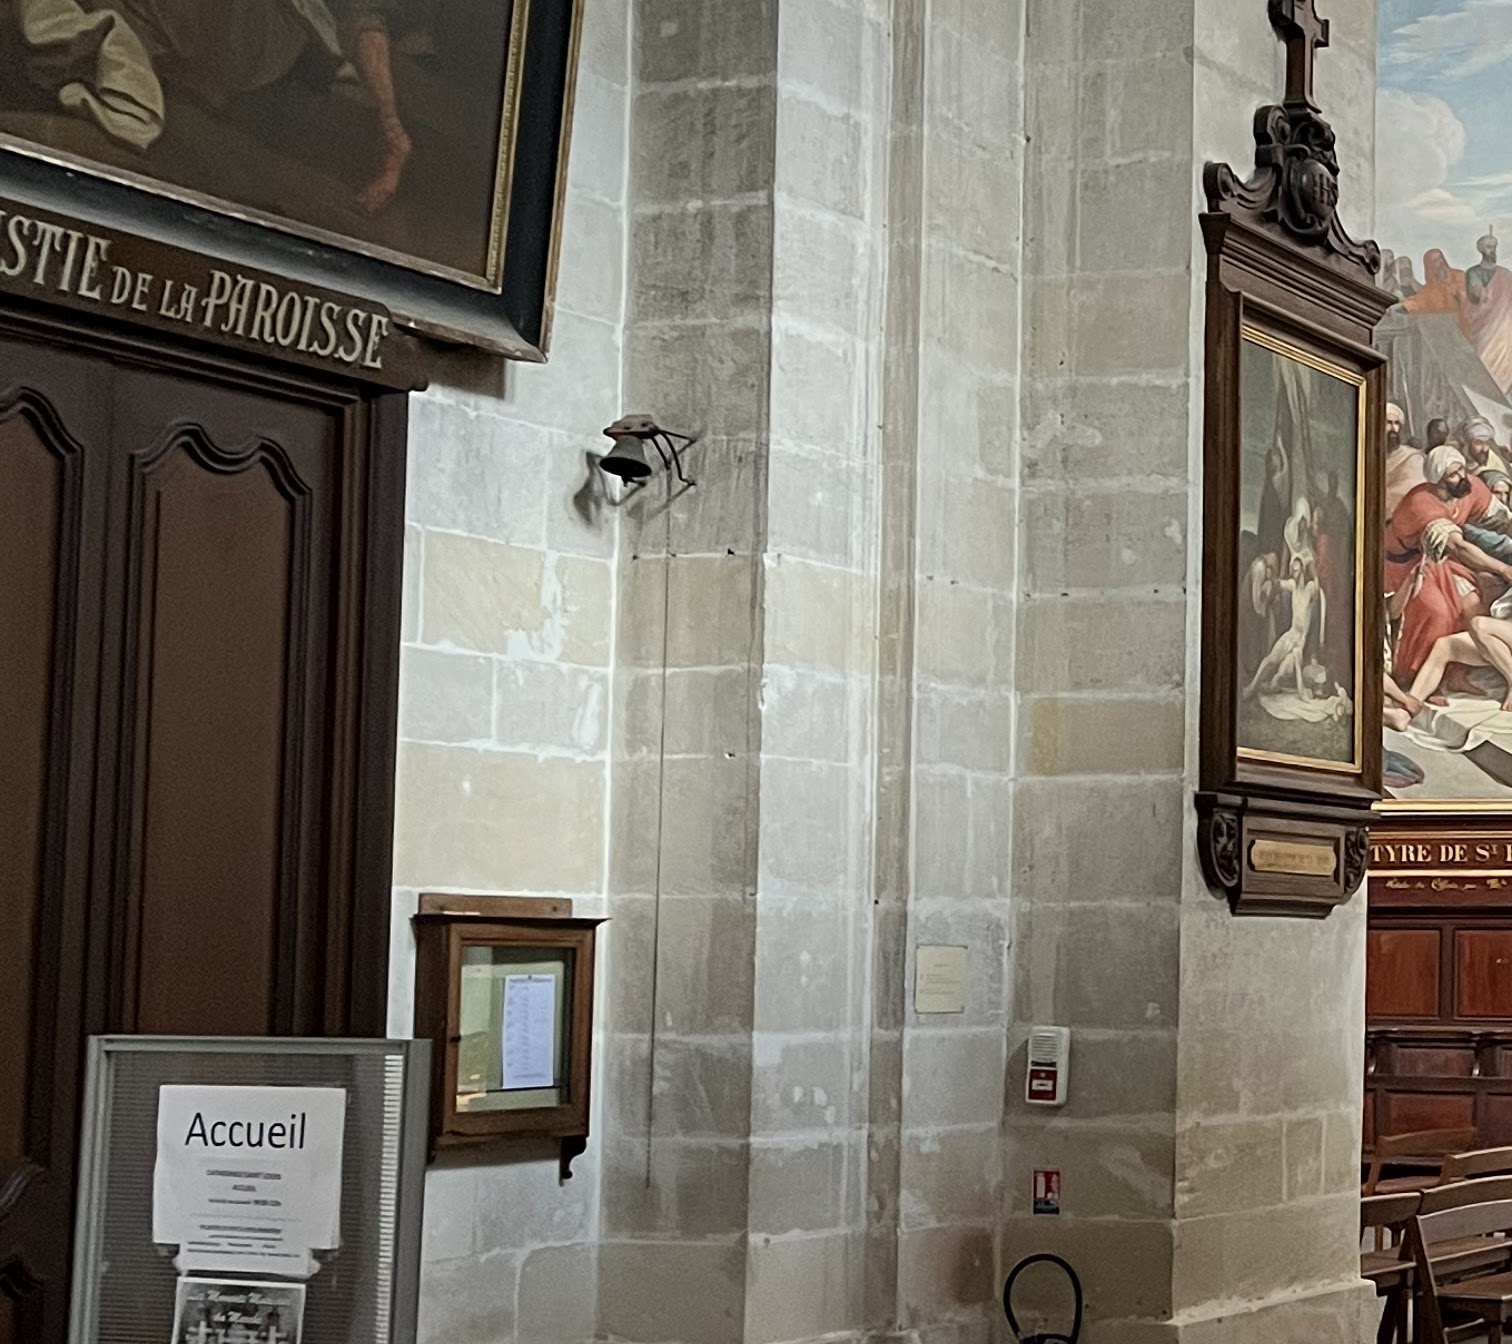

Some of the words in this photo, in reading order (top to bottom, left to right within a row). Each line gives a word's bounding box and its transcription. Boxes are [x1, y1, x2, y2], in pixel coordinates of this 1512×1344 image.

[109, 265, 154, 311] DE
[158, 279, 198, 323] LA
[200, 269, 390, 369] PAROISSE
[1440, 844, 1468, 862] DE
[184, 1111, 307, 1150] Accueil
